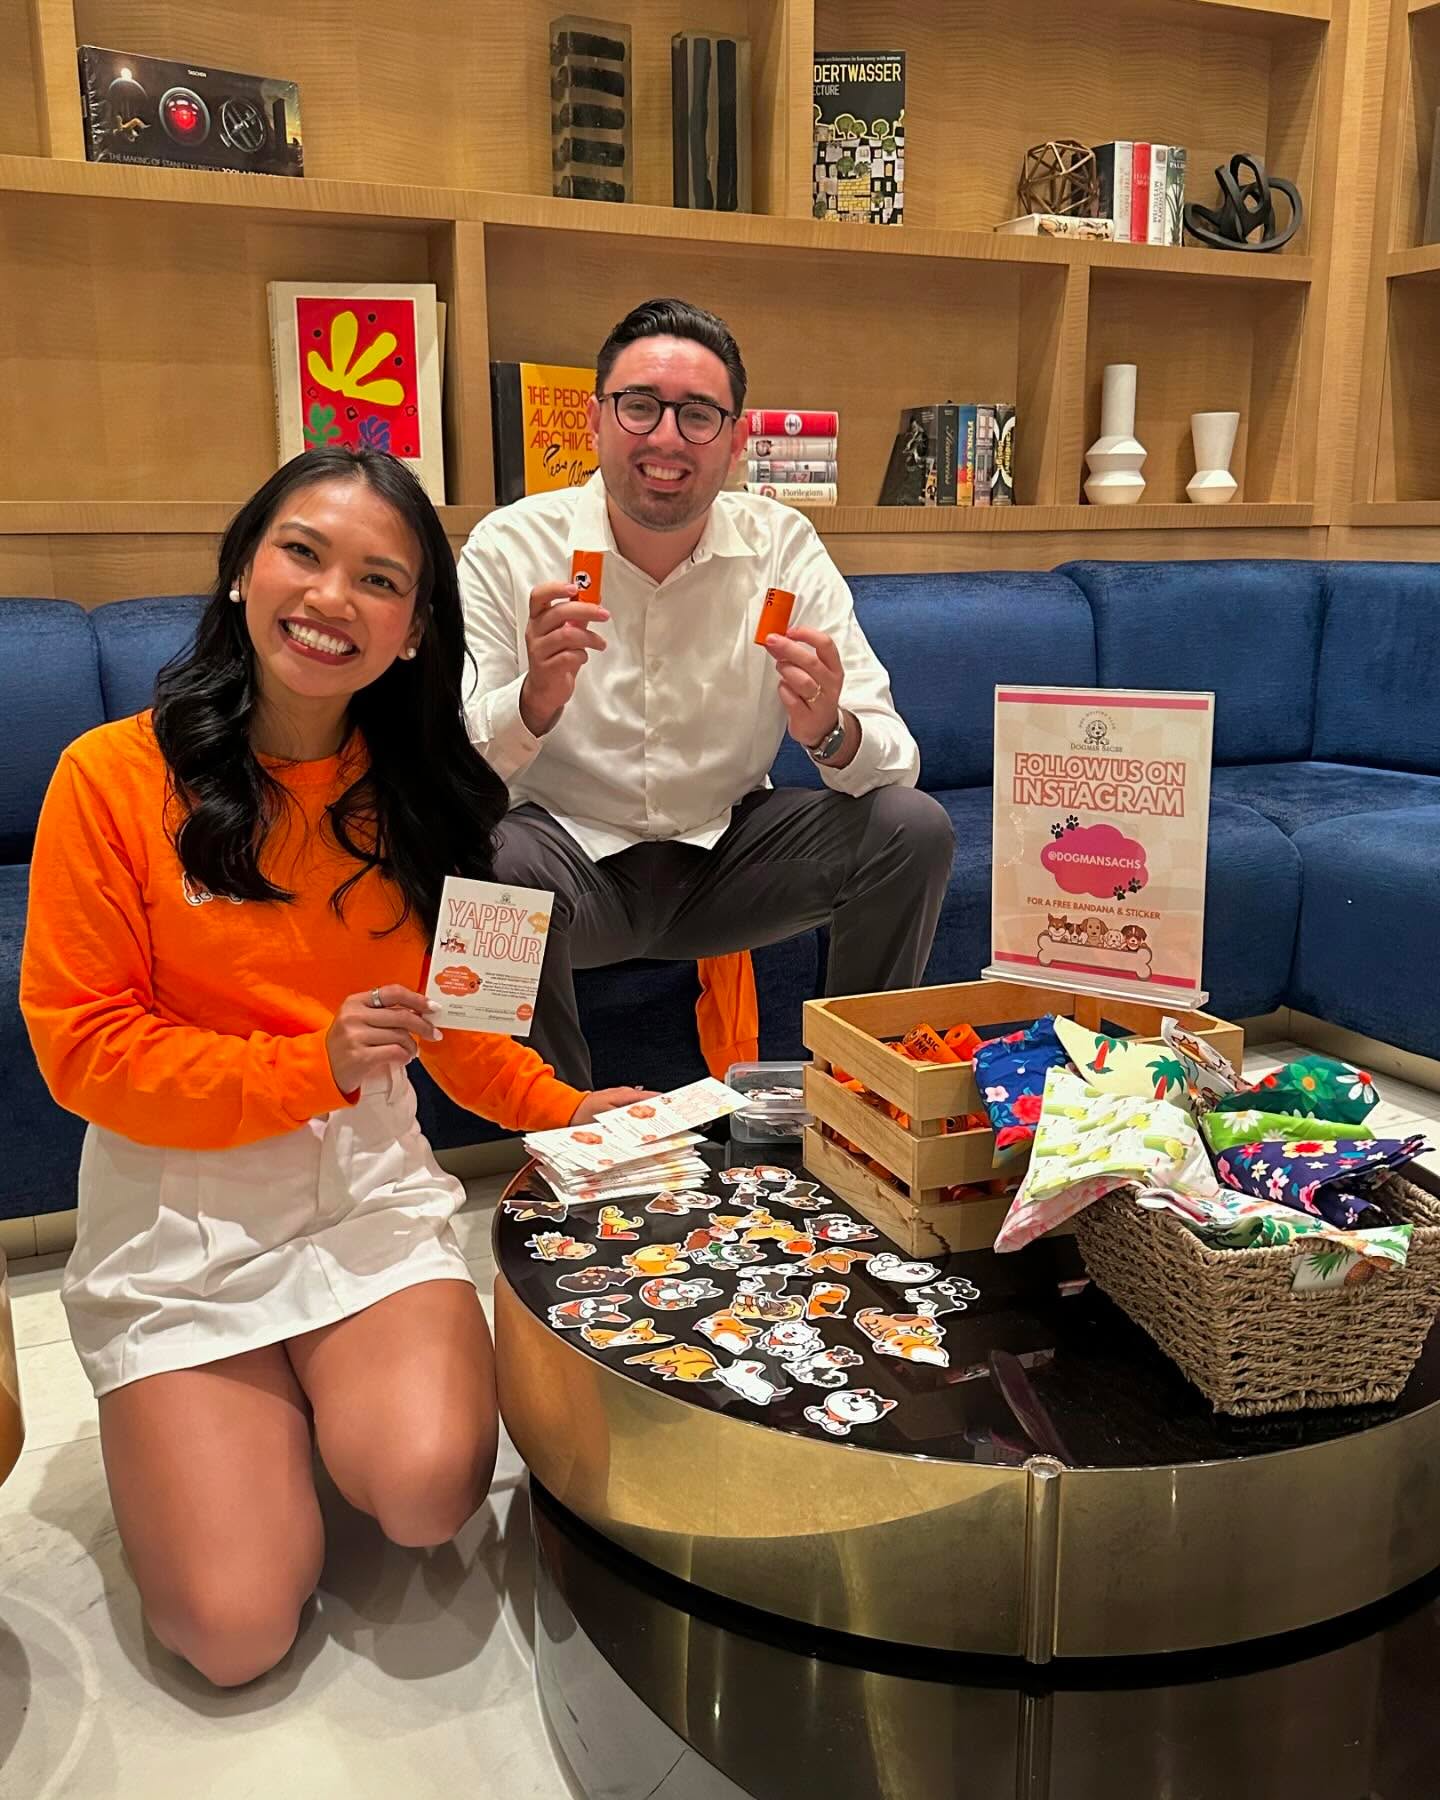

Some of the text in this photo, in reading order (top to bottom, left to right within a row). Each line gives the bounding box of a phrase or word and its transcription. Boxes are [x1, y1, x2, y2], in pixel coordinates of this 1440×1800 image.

[814, 63, 901, 83] DERTWASSER
[109, 153, 122, 161] THE
[528, 386, 549, 406] THE
[1014, 752, 1186, 786] FOLLOW US ON
[1013, 776, 1185, 817] INSTAGRAM
[1048, 850, 1141, 870] @DOGMANSACHS
[447, 898, 529, 935] YAPPY
[1027, 896, 1161, 920] FOR A FREE BANDANA & STICKER
[472, 930, 542, 965] HOUR
